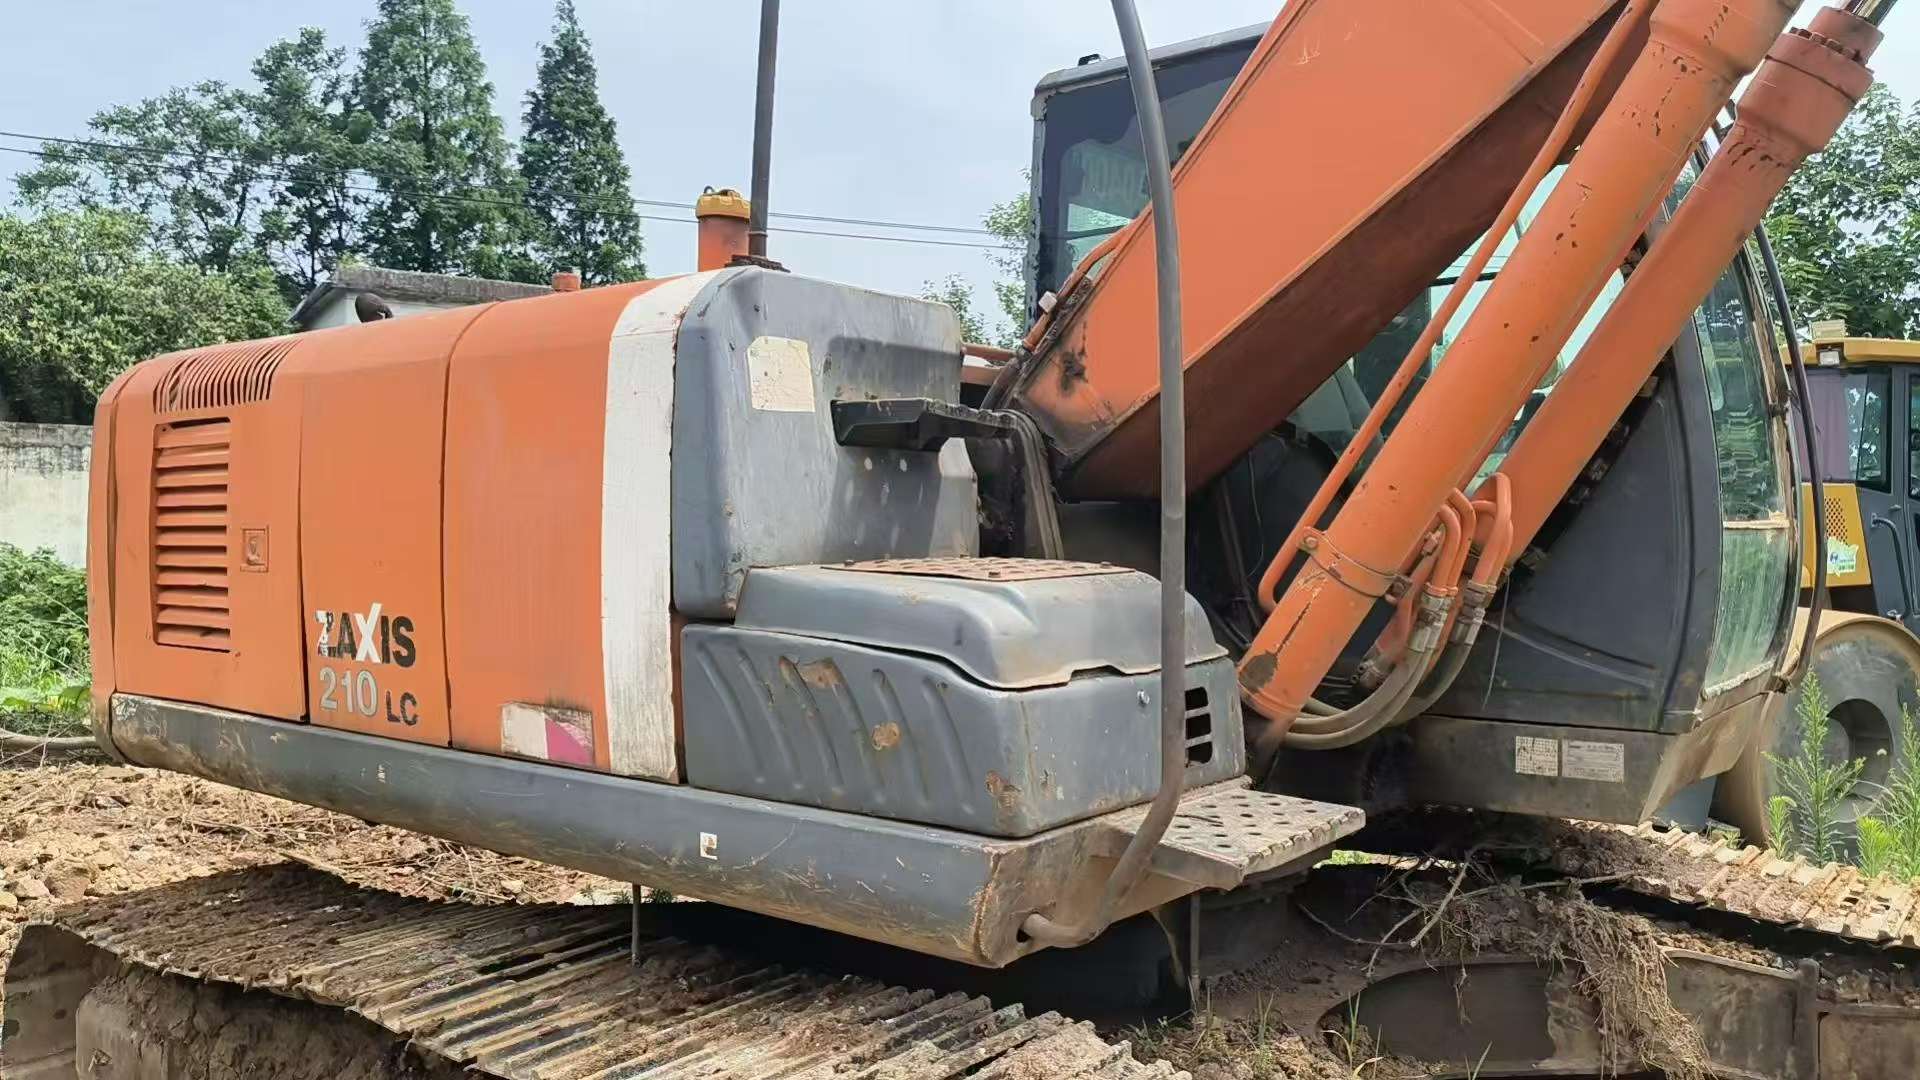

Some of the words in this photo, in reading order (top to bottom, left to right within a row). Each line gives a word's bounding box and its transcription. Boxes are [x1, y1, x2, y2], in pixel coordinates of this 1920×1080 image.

[316, 602, 416, 668] ZAXIS
[320, 667, 378, 717] 210
[385, 690, 418, 726] LC
